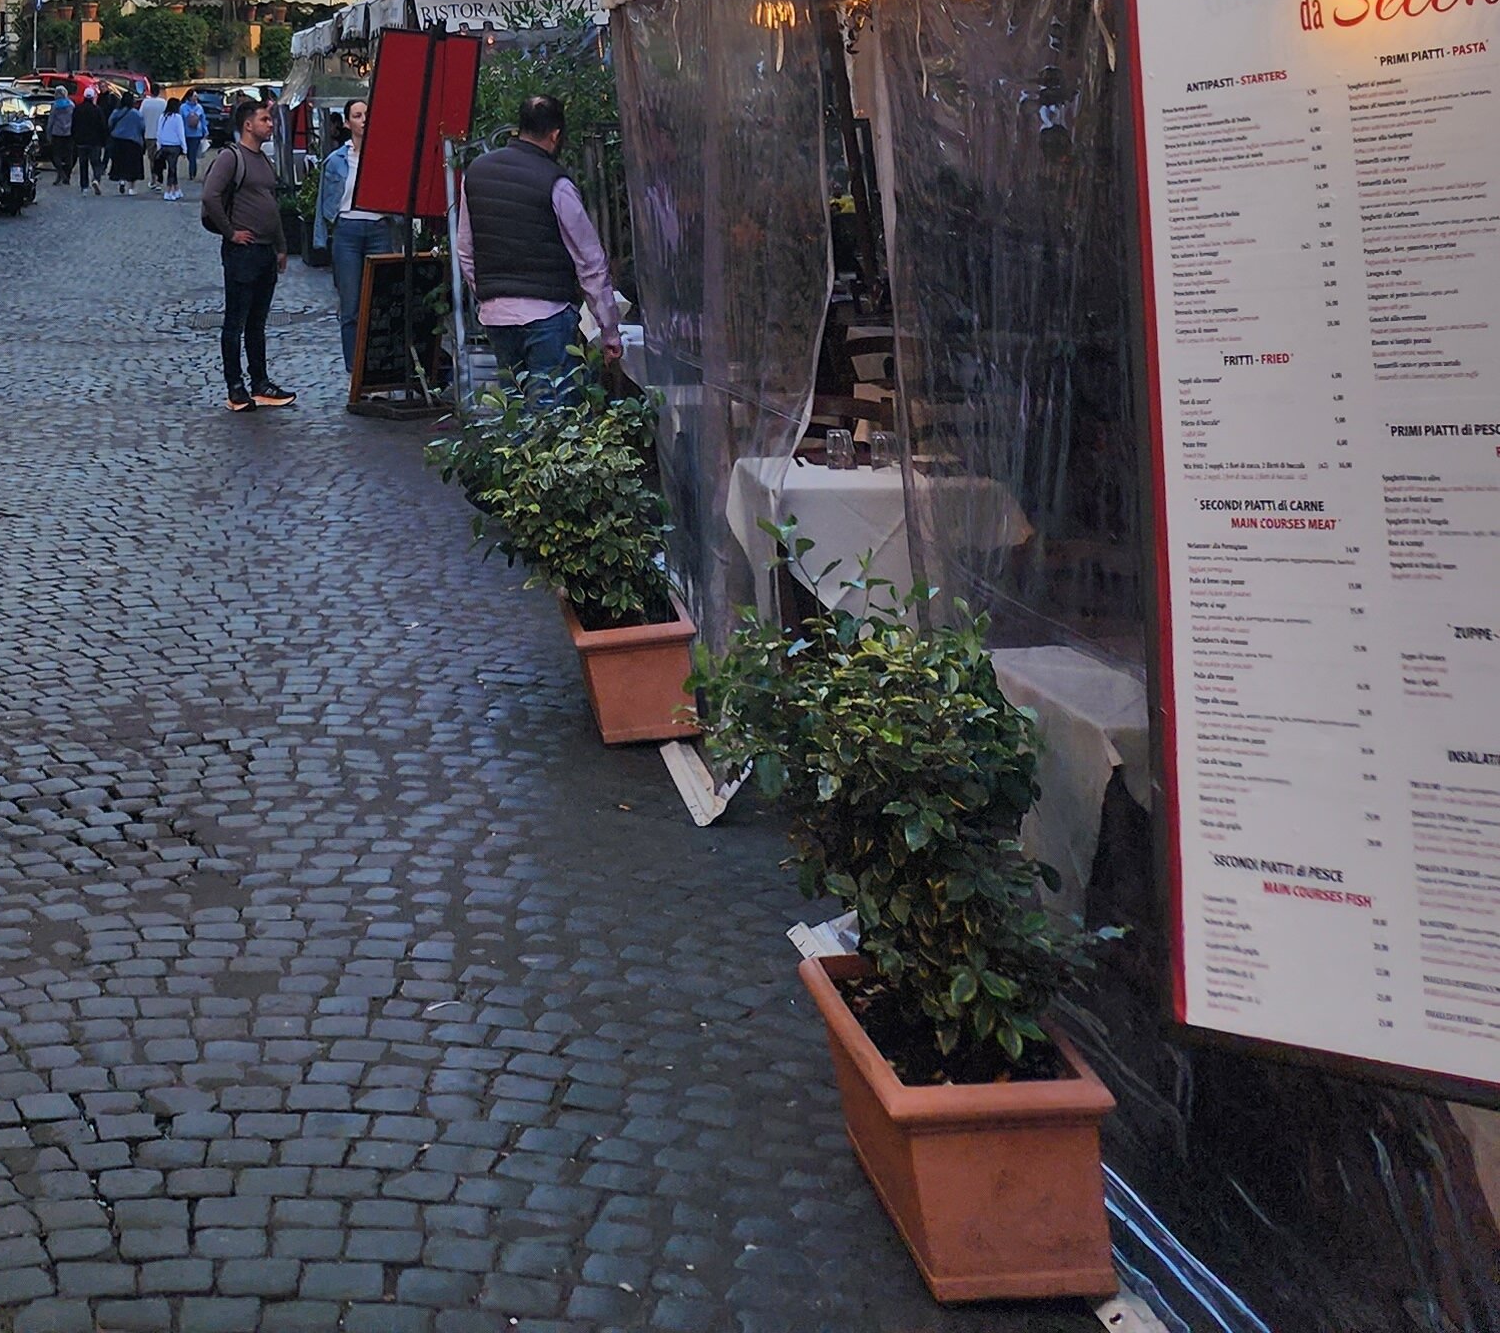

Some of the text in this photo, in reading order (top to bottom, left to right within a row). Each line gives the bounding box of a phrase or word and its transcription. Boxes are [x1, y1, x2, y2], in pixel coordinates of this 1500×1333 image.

[1380, 42, 1486, 66] PRIMI PIATTI PASTA
[1186, 70, 1288, 93] ANTIPASTI STARTERS
[1223, 353, 1290, 366] FRITTI FRIED
[1391, 425, 1422, 436] PRIMI
[1424, 425, 1459, 436] PIATTI
[1461, 424, 1472, 435] di
[1200, 499, 1325, 512] SECONDI PIATTI di CARNE
[1231, 517, 1337, 530] MAIN COURSES MEAT
[1307, 866, 1344, 883] PESCE
[1263, 880, 1372, 908] MAIN COURSES FISH
